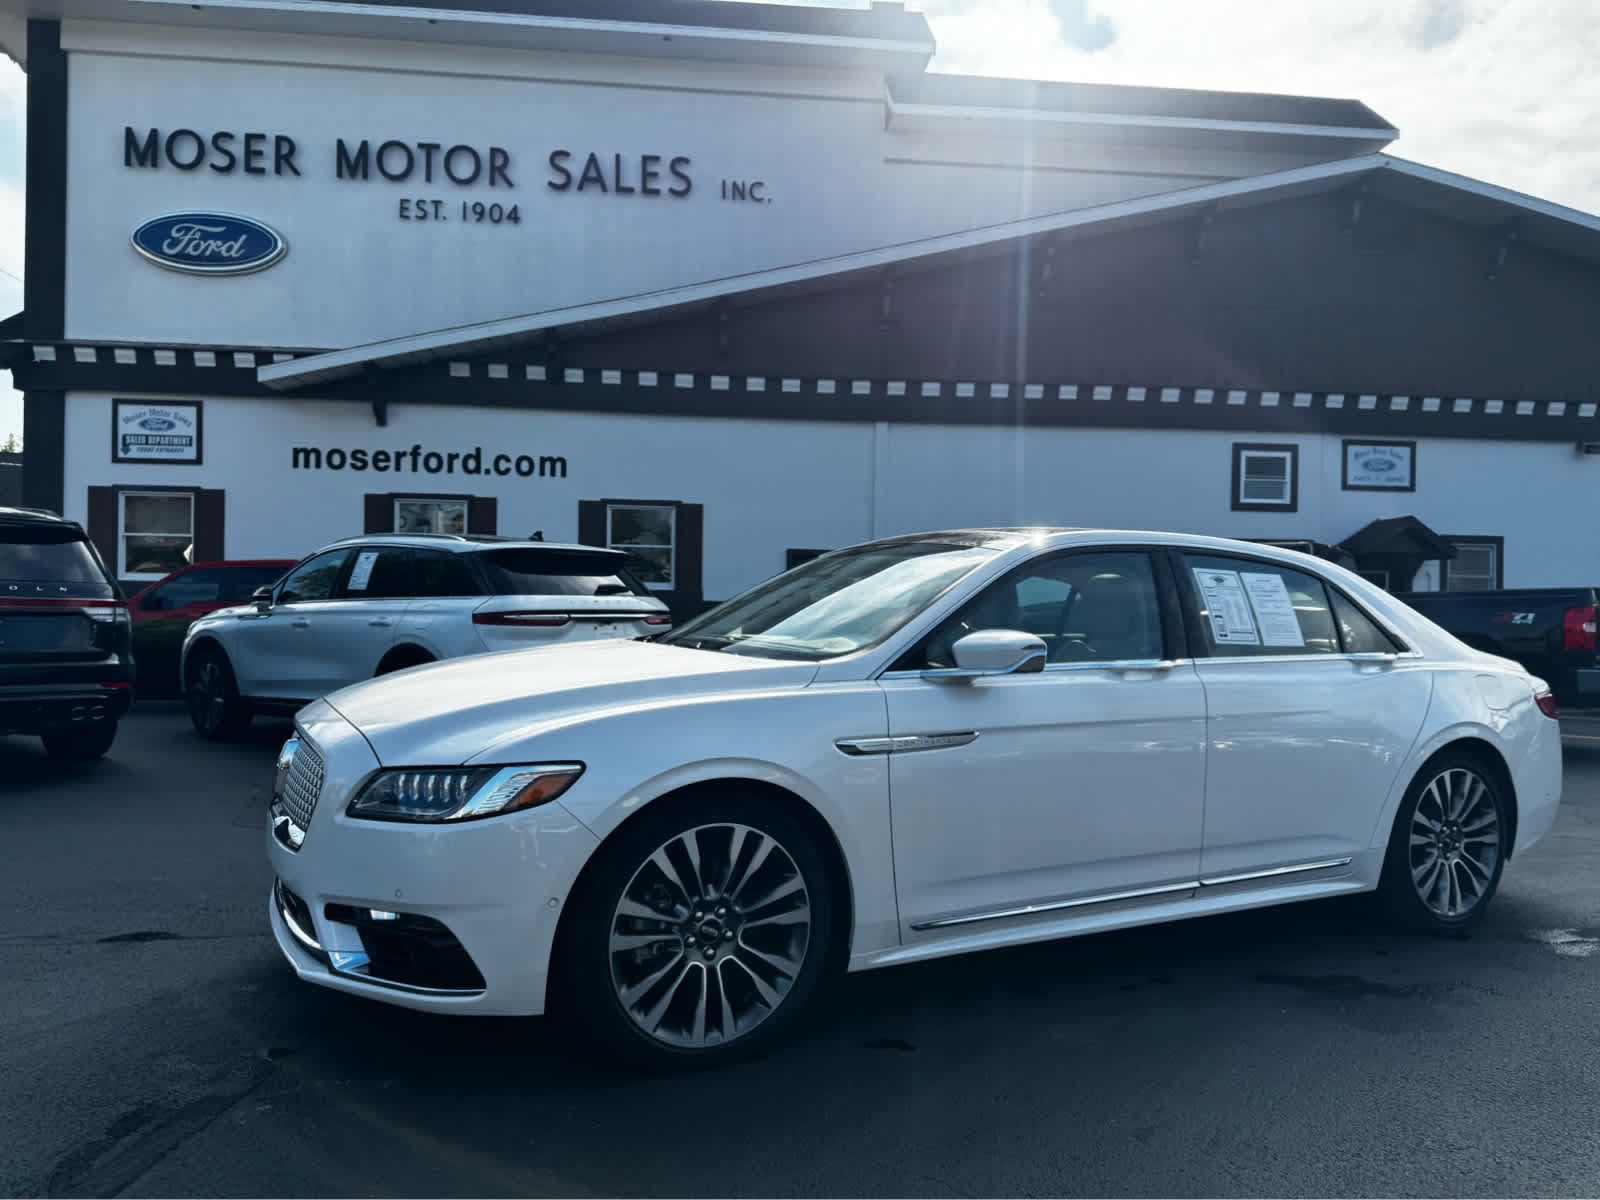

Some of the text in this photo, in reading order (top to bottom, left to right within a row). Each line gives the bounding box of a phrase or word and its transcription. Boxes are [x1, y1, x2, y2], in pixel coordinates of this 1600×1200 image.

[123, 126, 772, 203] MOSER MOTOR SALES INC.
[399, 199, 521, 225] EST. 1904
[162, 223, 248, 258] Ford
[292, 445, 567, 478] moserford.com
